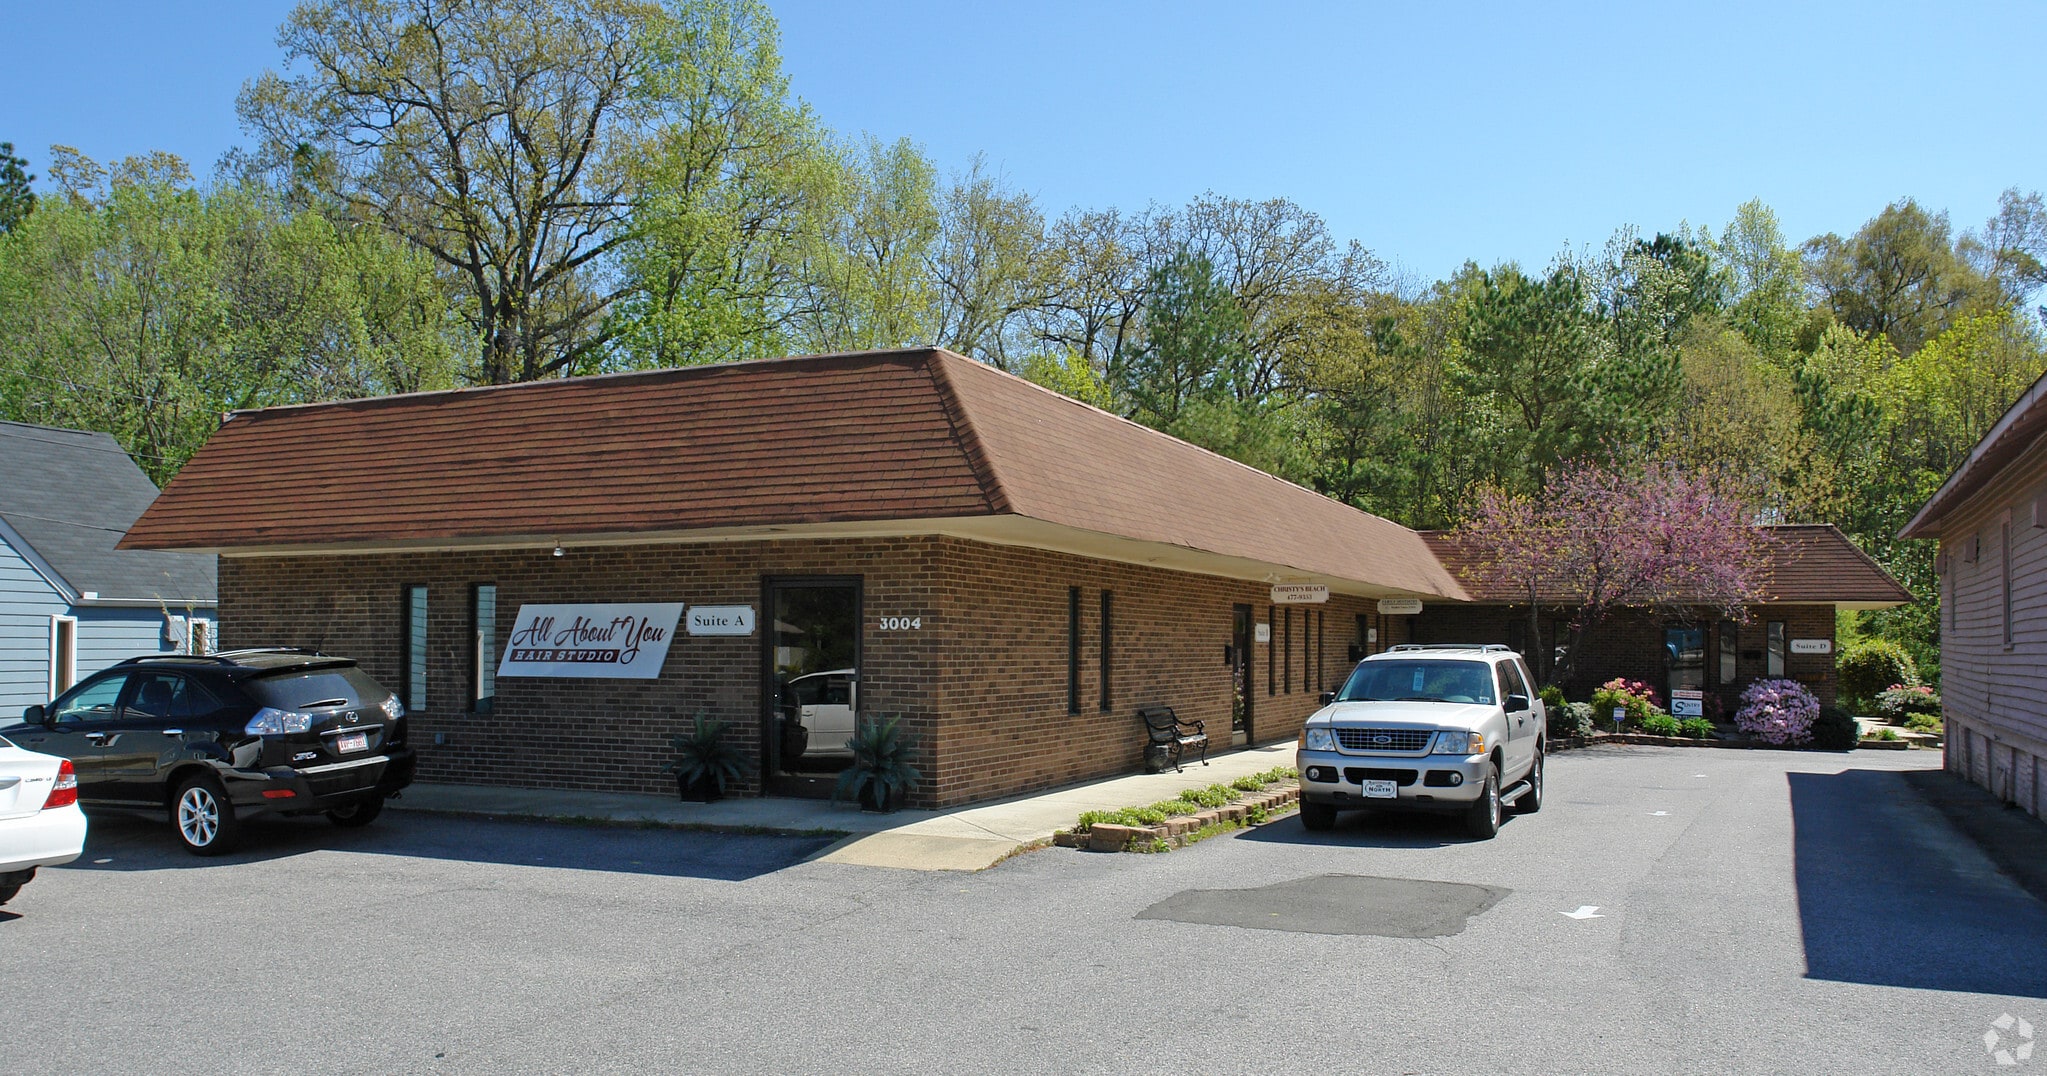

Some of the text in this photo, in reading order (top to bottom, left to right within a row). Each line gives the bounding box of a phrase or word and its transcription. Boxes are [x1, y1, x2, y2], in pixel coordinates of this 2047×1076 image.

[694, 614, 745, 627] Suite A
[880, 617, 921, 630] 3004
[512, 615, 666, 664] All About You
[514, 651, 614, 661] HAIR STUDIO
